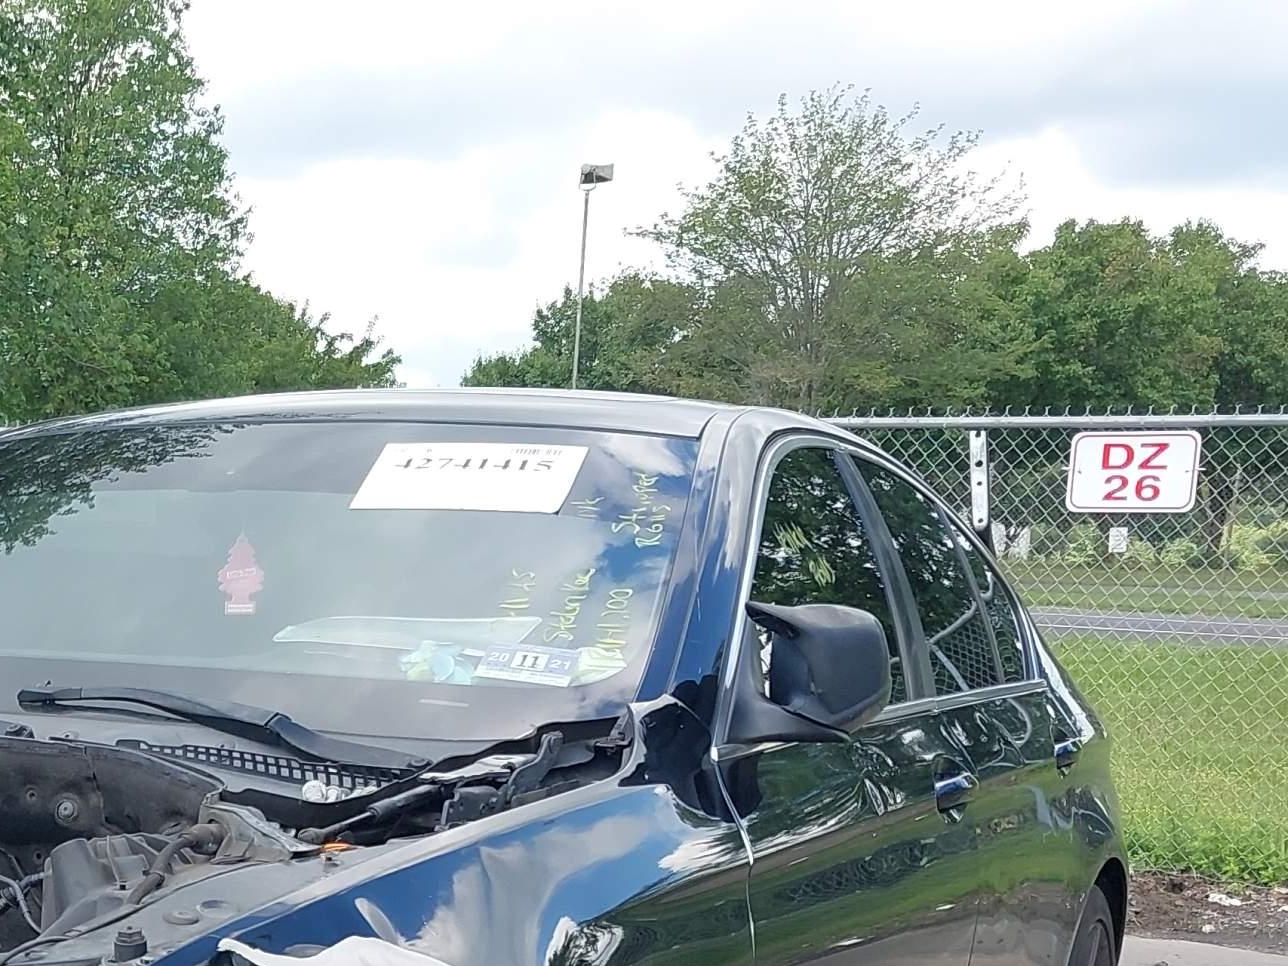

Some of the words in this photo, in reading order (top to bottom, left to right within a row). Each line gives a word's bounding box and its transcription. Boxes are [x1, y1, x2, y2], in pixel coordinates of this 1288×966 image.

[394, 458, 555, 472] 42741415
[1101, 442, 1170, 470] DZ
[1102, 474, 1162, 502] 26
[489, 651, 511, 662] 20
[515, 654, 540, 669] 11
